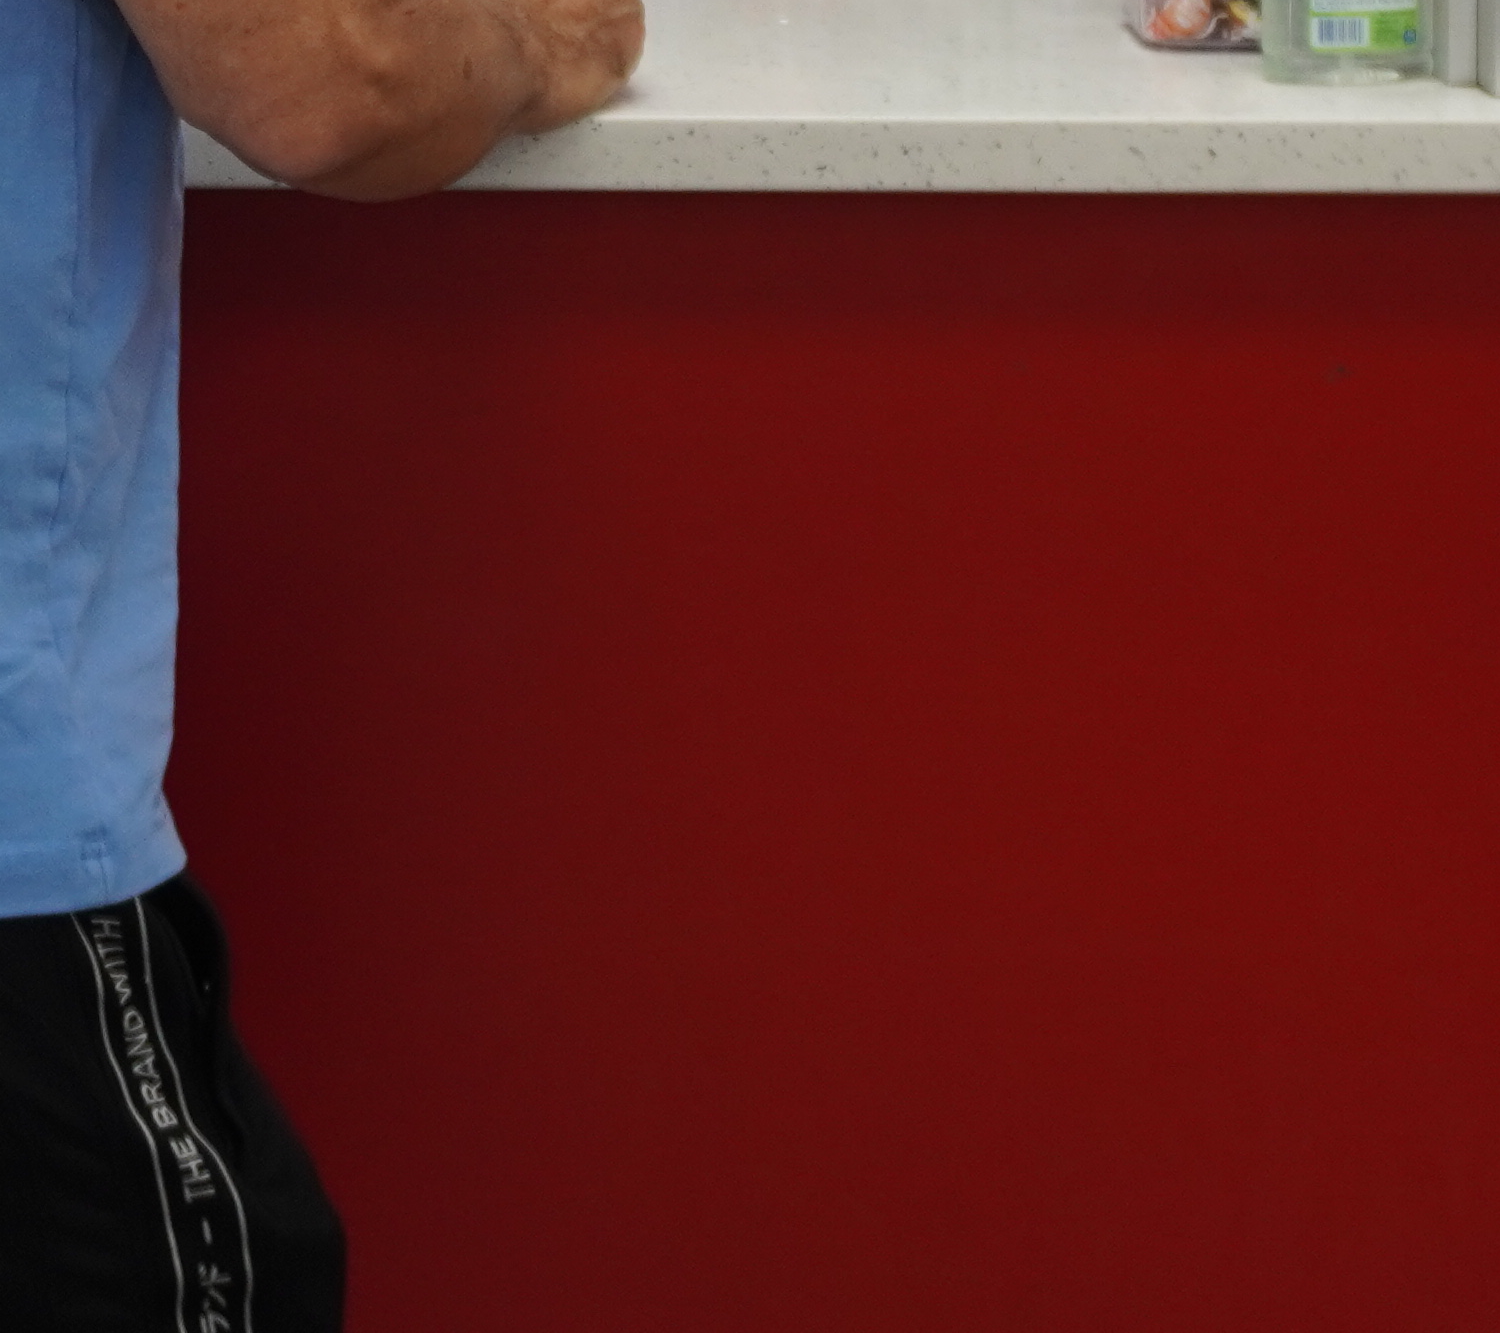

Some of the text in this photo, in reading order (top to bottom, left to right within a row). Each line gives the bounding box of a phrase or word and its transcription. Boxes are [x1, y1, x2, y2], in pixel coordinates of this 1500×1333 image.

[90, 916, 217, 1204] THE BRAND WITH
